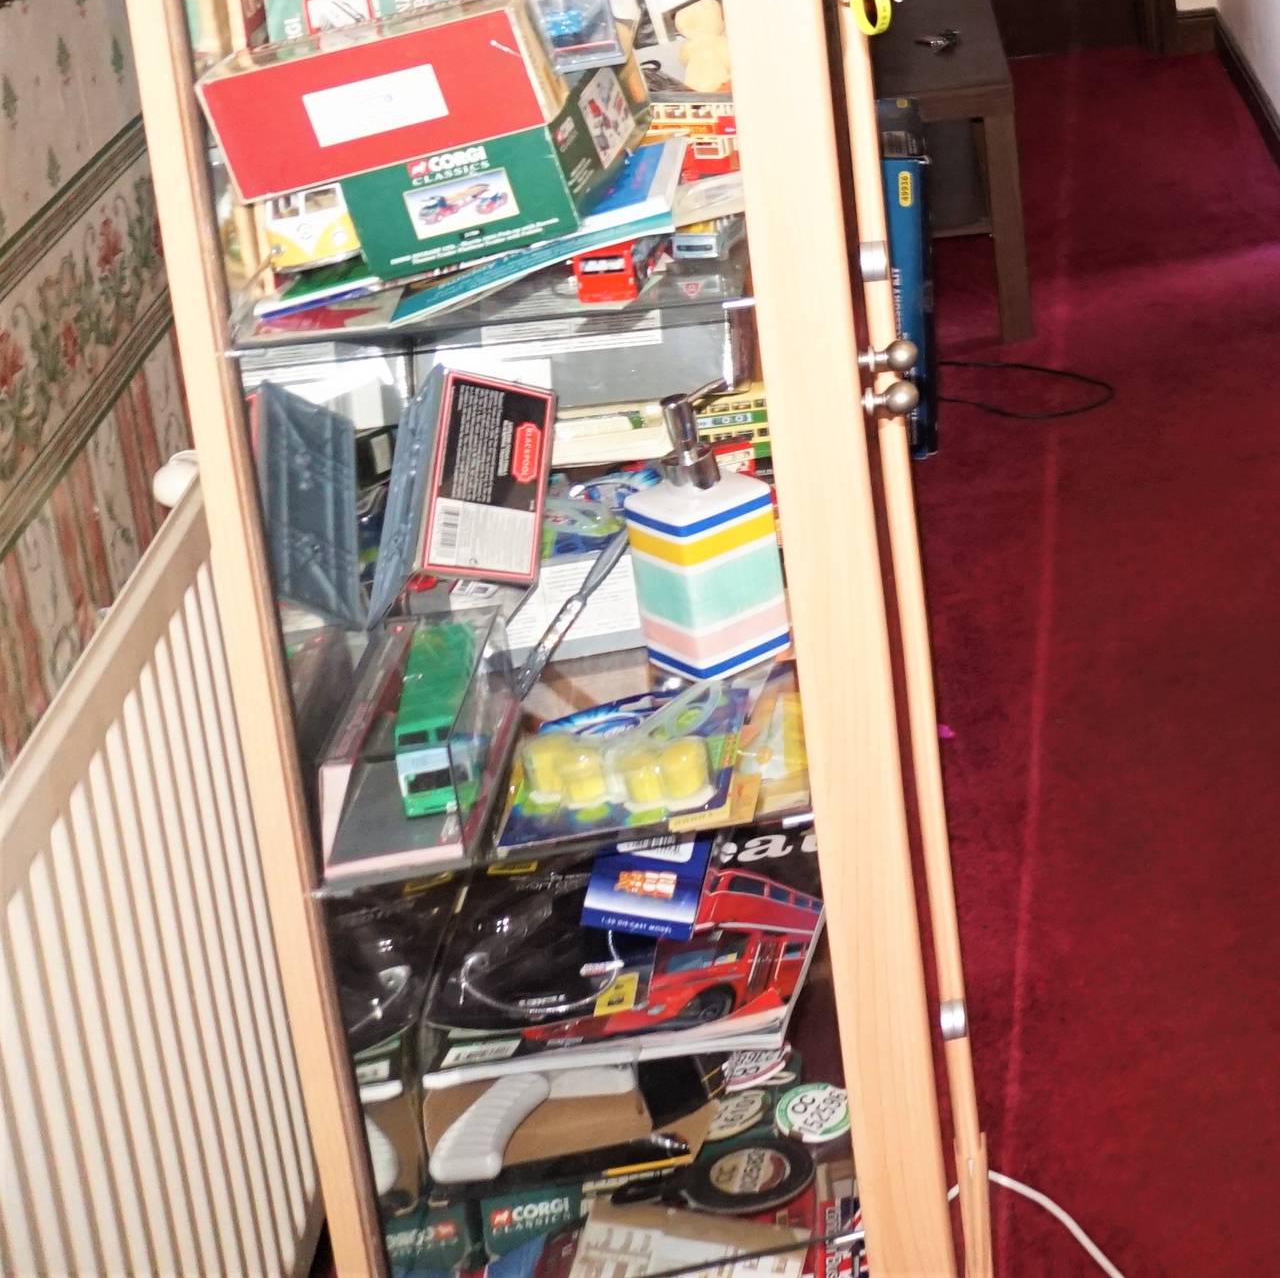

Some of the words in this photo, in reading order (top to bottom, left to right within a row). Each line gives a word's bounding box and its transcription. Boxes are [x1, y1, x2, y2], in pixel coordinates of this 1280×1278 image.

[428, 145, 488, 173] CORGI
[412, 160, 491, 187] CLASSICS
[521, 425, 534, 476] BLACKPOOL
[791, 1094, 816, 1114] OC
[511, 1197, 570, 1222] CORGI
